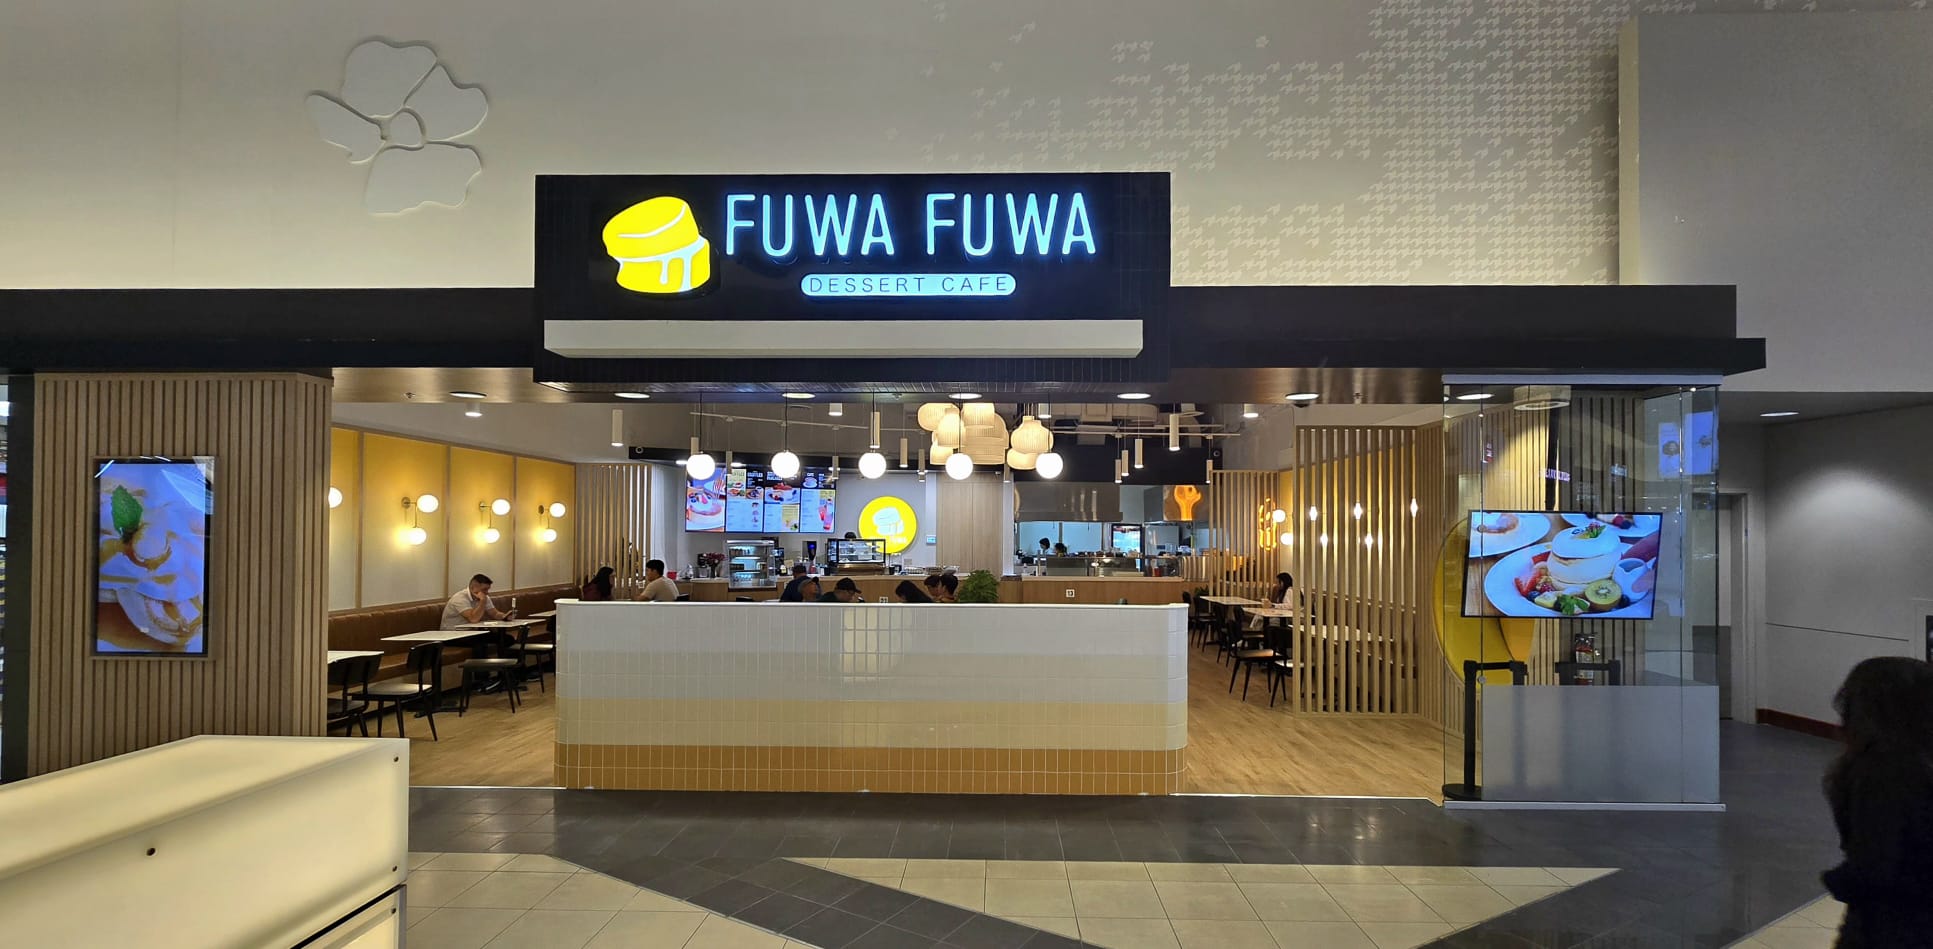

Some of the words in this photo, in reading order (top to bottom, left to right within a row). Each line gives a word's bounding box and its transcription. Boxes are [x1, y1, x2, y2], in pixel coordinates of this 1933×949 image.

[725, 192, 894, 256] FUWA
[925, 192, 1096, 255] FUWA
[809, 276, 926, 293] DESSERT
[941, 275, 1008, 292] CAFE
